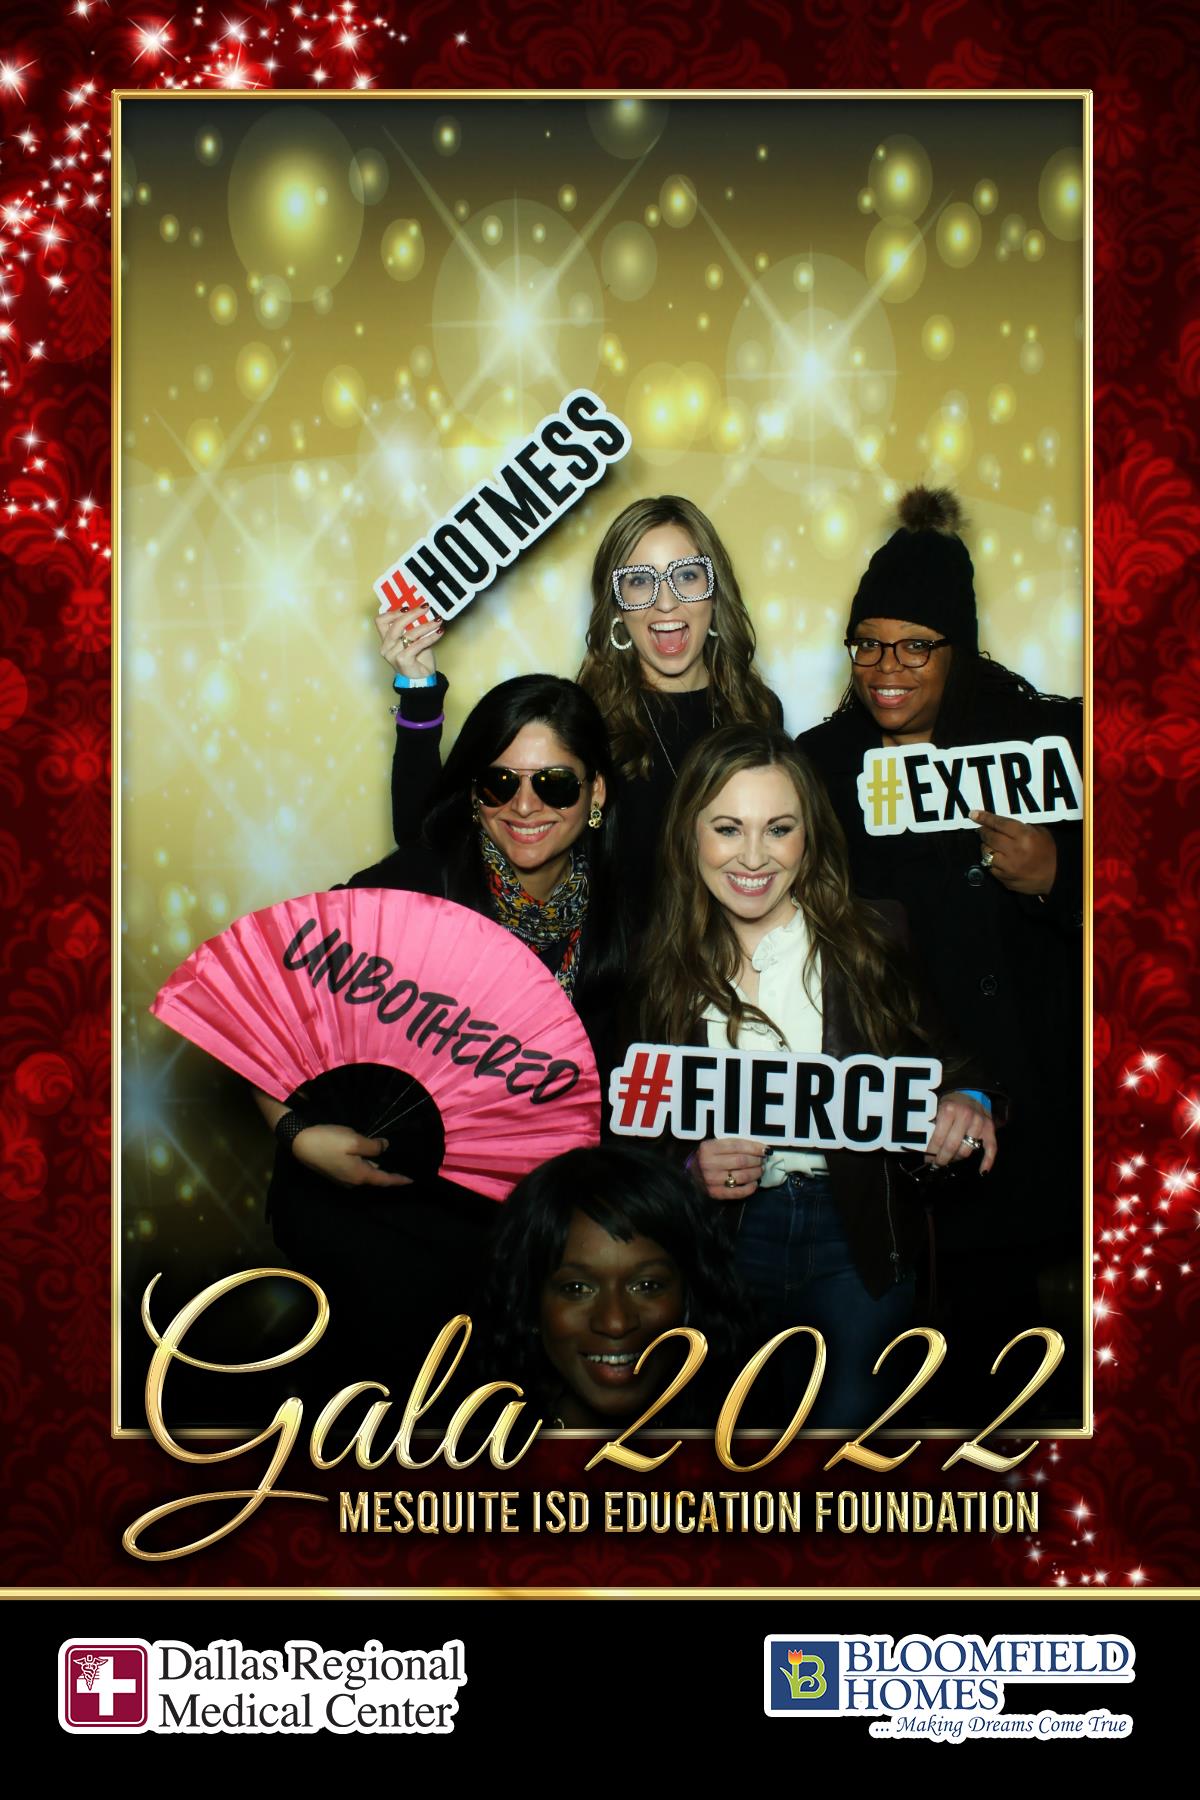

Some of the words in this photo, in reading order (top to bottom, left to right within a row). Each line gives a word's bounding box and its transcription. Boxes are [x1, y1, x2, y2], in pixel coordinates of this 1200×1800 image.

[867, 747, 1079, 826] #EXTRA
[283, 918, 580, 1105] UNBOTHERED
[618, 1052, 931, 1144] #FIERCE
